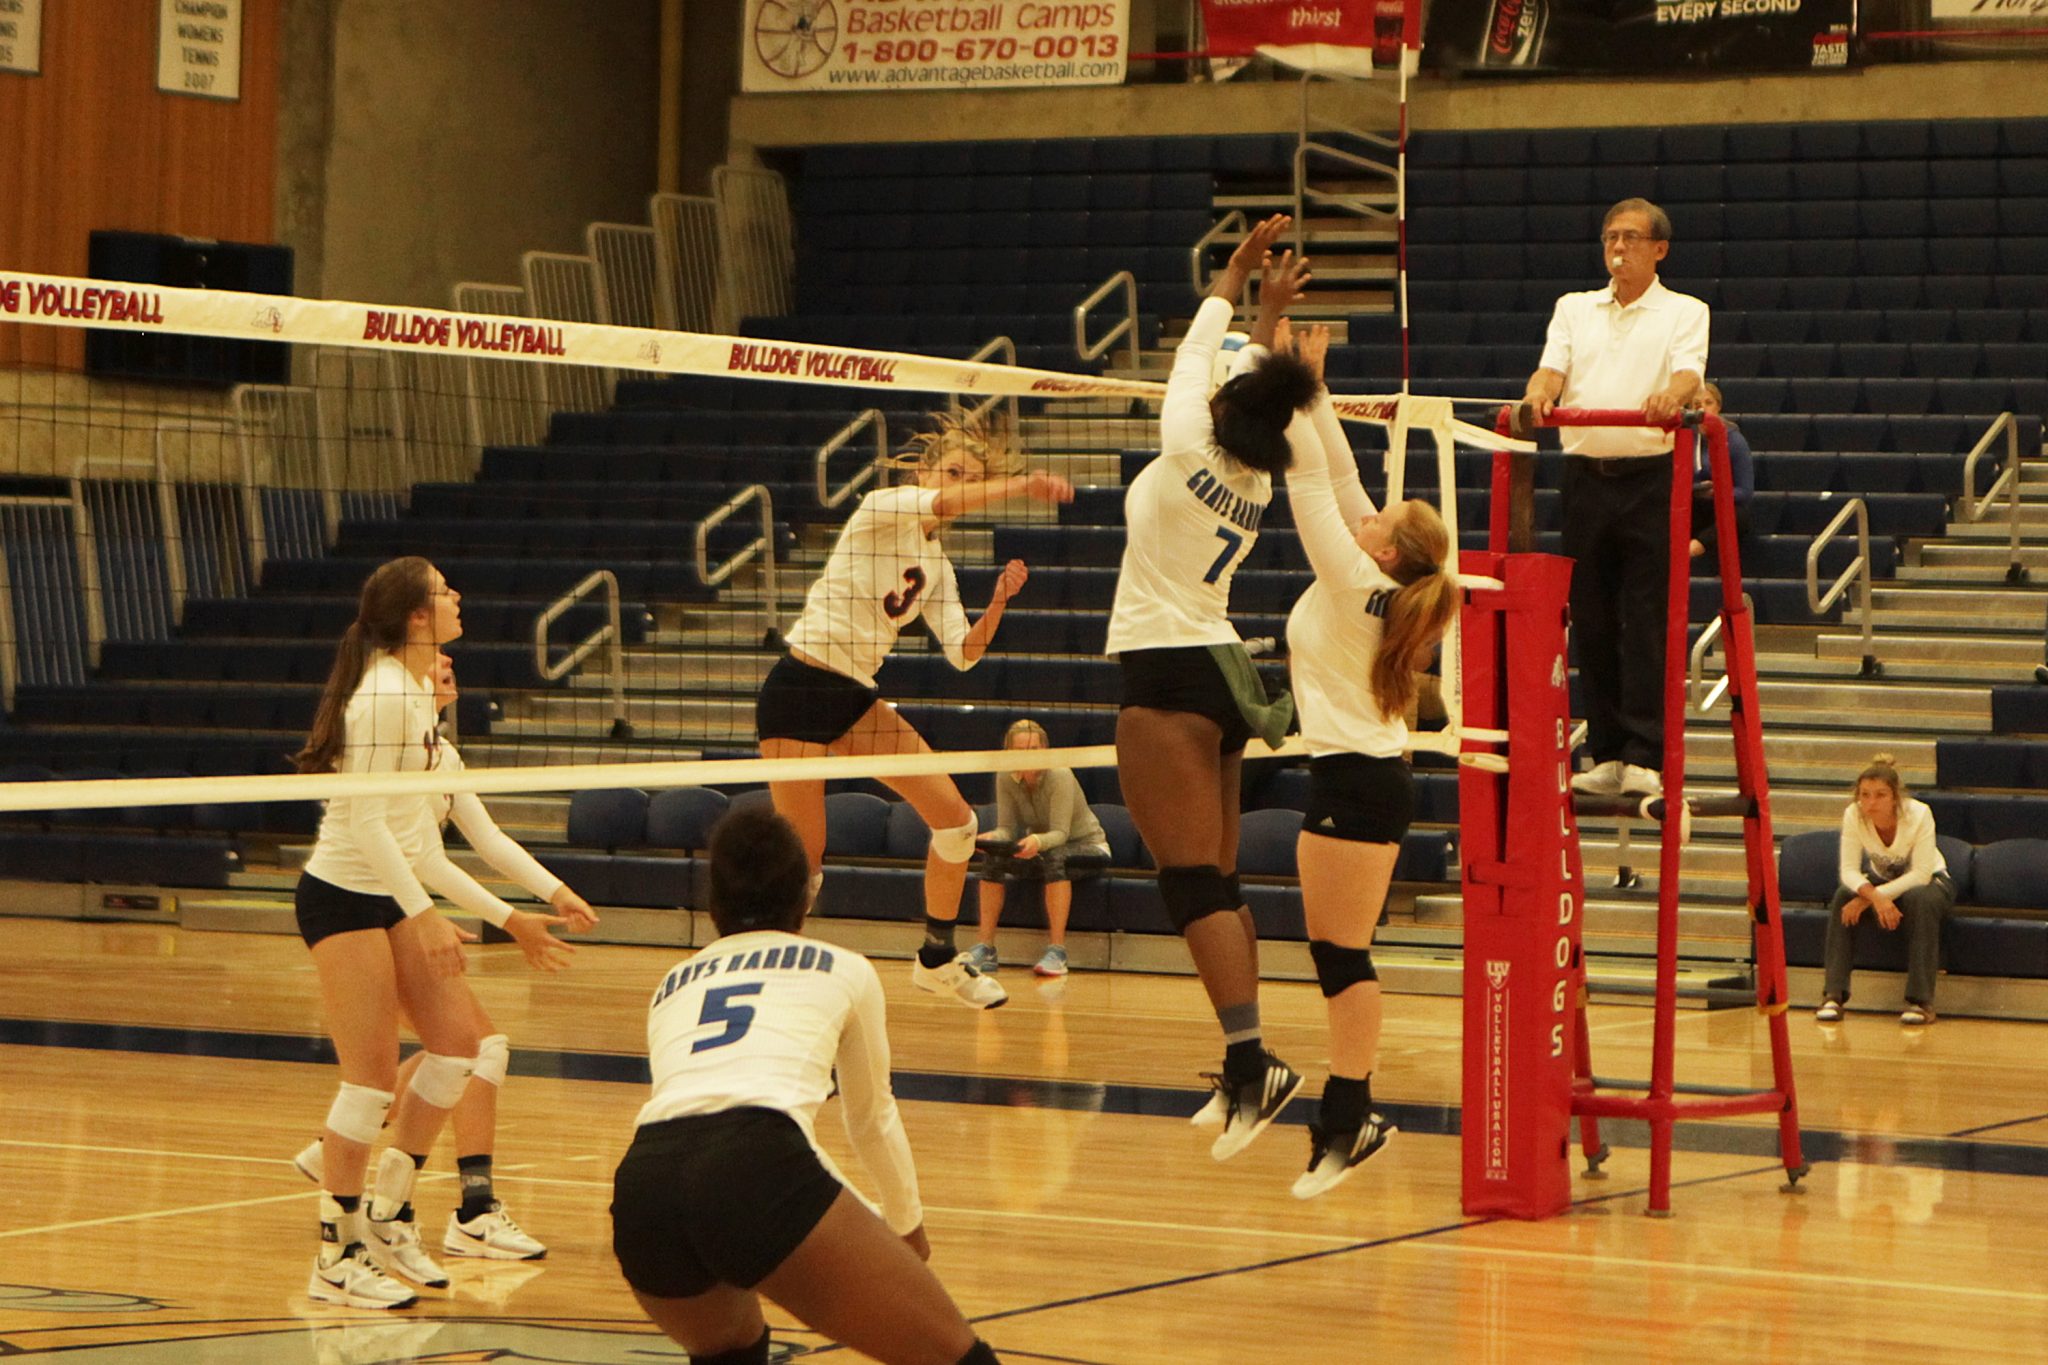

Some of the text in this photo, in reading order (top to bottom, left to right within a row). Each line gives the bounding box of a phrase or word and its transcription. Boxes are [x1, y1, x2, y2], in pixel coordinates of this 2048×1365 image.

[847, 3, 1116, 34] Basketball Camps
[1657, 0, 1800, 22] EVERY SECOND
[182, 47, 219, 66] TENNIS
[843, 34, 1119, 63] 1-800-670-0013
[829, 62, 1119, 83] www.advantagebasketball.com
[27, 282, 164, 324] VOLLEYBALL
[456, 319, 566, 355] VOLLEYBALL
[806, 351, 898, 382] VOLLEYBALL
[1202, 525, 1243, 585] 7
[884, 565, 926, 619] 3
[1549, 717, 1574, 1057] BULLDOGS
[726, 945, 835, 973] HARBOR
[690, 982, 765, 1055] 5
